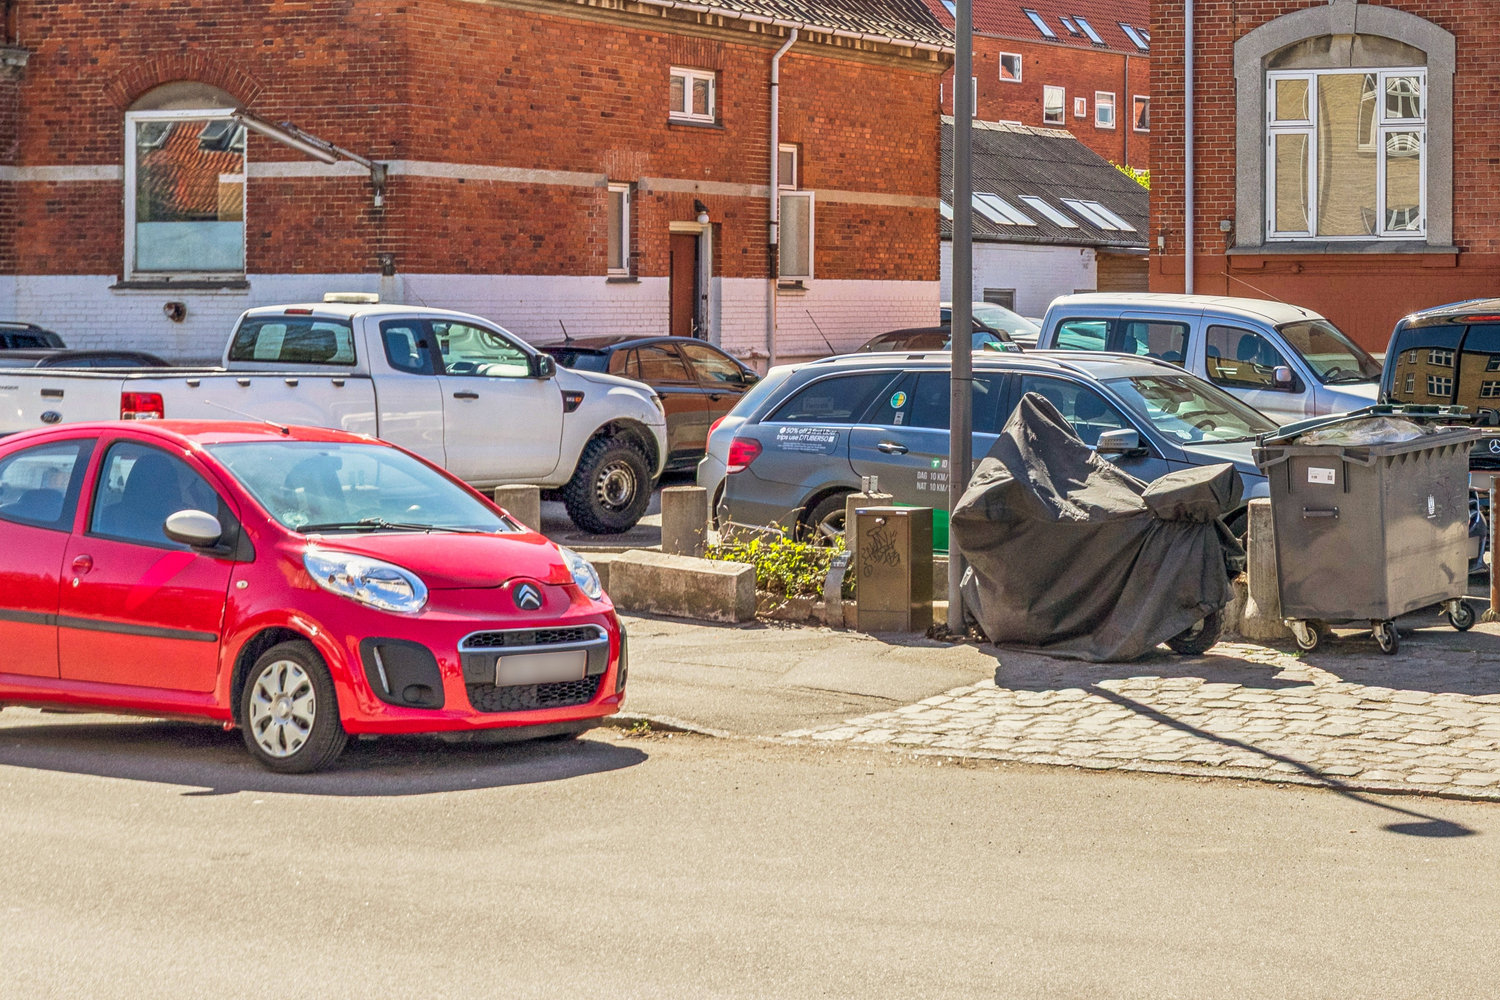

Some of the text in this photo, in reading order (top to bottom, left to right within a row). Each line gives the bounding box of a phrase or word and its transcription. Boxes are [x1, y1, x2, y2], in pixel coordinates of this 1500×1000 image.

[916, 471, 928, 480] DAG
[930, 472, 937, 480] 10
[916, 481, 927, 490] NAT
[930, 482, 937, 491] 10
